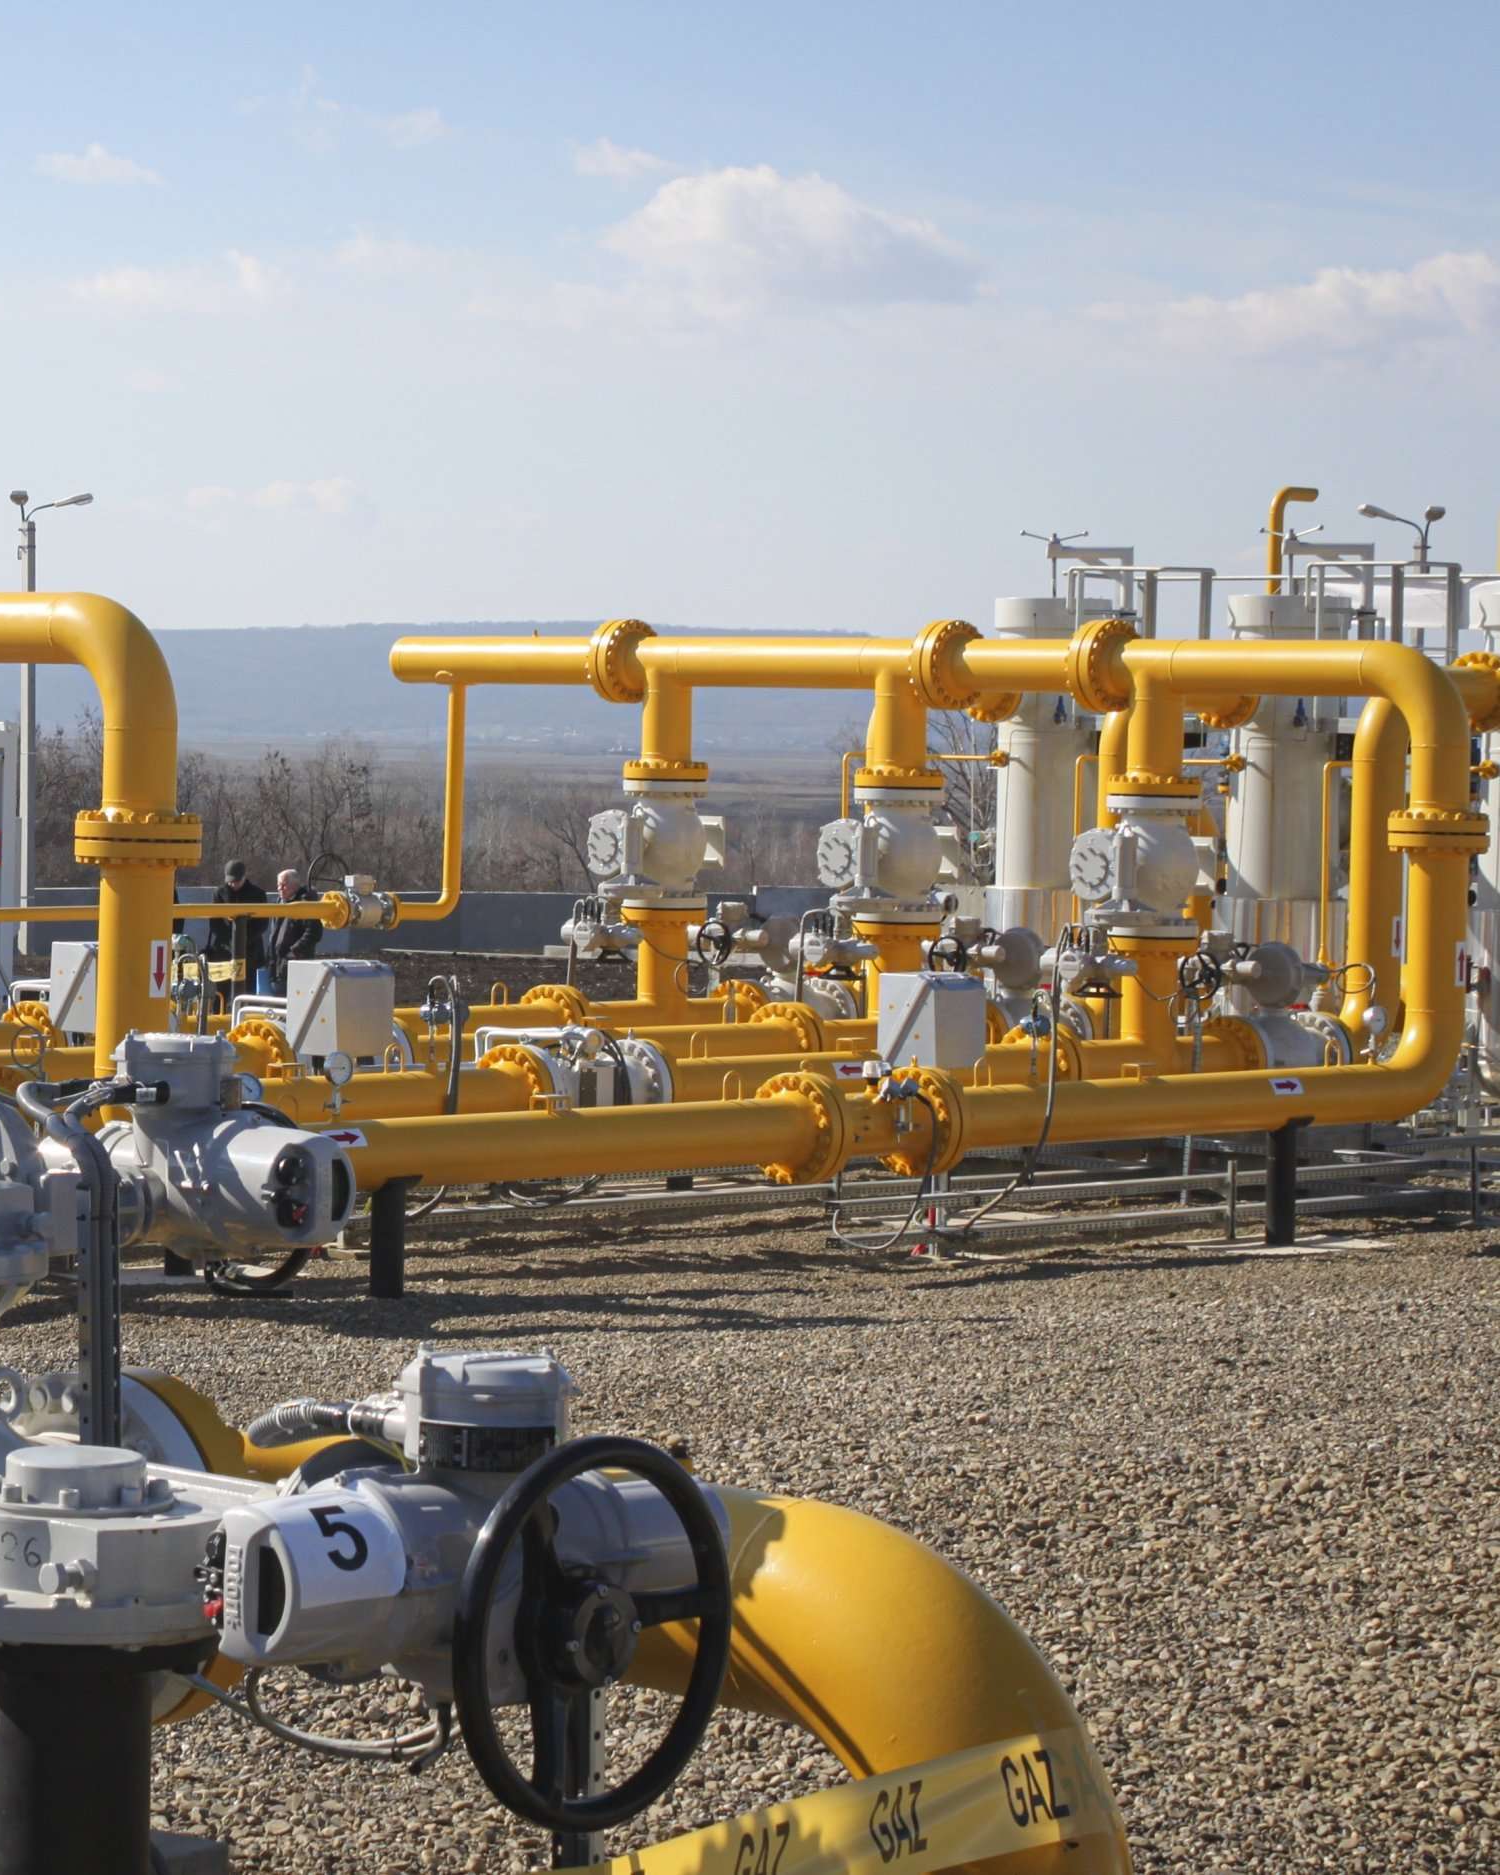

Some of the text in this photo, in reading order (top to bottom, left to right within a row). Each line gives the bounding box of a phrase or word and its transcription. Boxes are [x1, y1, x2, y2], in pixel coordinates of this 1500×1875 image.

[309, 1505, 368, 1571] 5
[735, 1821, 790, 1875] GAZ
[869, 1780, 929, 1863] GAZ
[1001, 1750, 1070, 1827] GAZ
